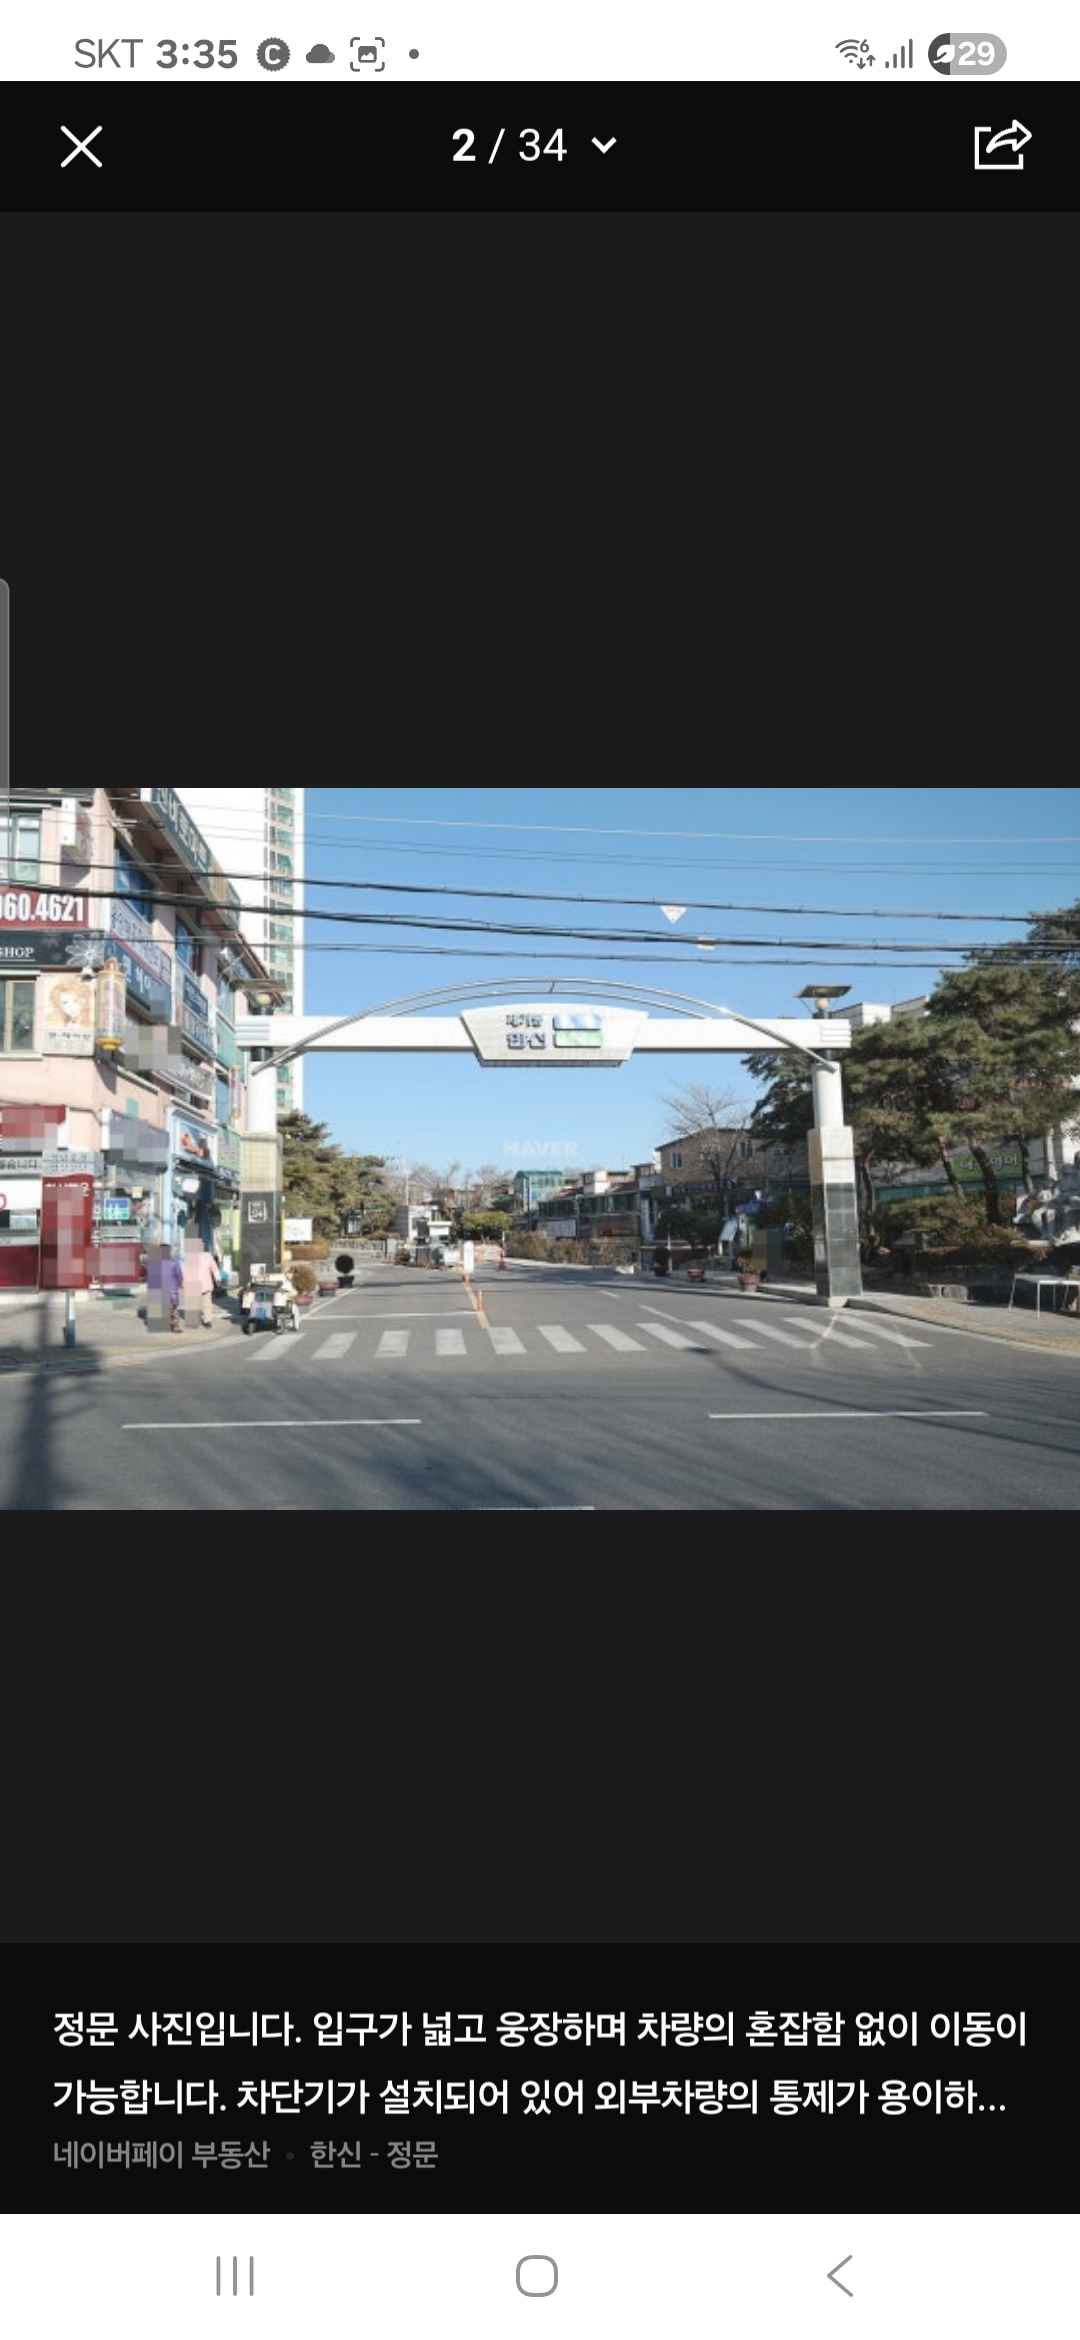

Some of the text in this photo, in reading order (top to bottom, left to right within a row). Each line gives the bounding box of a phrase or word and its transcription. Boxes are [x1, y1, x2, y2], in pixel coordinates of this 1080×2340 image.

[74, 39, 237, 69] SKT 3:35
[958, 41, 995, 66] 29
[452, 128, 567, 164] 2 / 34
[0, 892, 84, 922] 60.4621
[54, 2011, 1027, 2047] 정문 사진입니다. 입구가 넓고 웅장하며 차량의 혼잡함 없이 이동이
[53, 2079, 226, 2115] 가능합니다.
[237, 2079, 370, 2115] 차단기가
[379, 2079, 508, 2115] 설치되어
[521, 2079, 583, 2115] 있어
[595, 2079, 757, 2115] 외부차량의
[770, 2079, 869, 2115] 통제가
[54, 2141, 182, 2169] 네이버페이
[192, 2141, 271, 2169] 부동산
[310, 2141, 361, 2169] 한신
[387, 2141, 438, 2169] 정문
